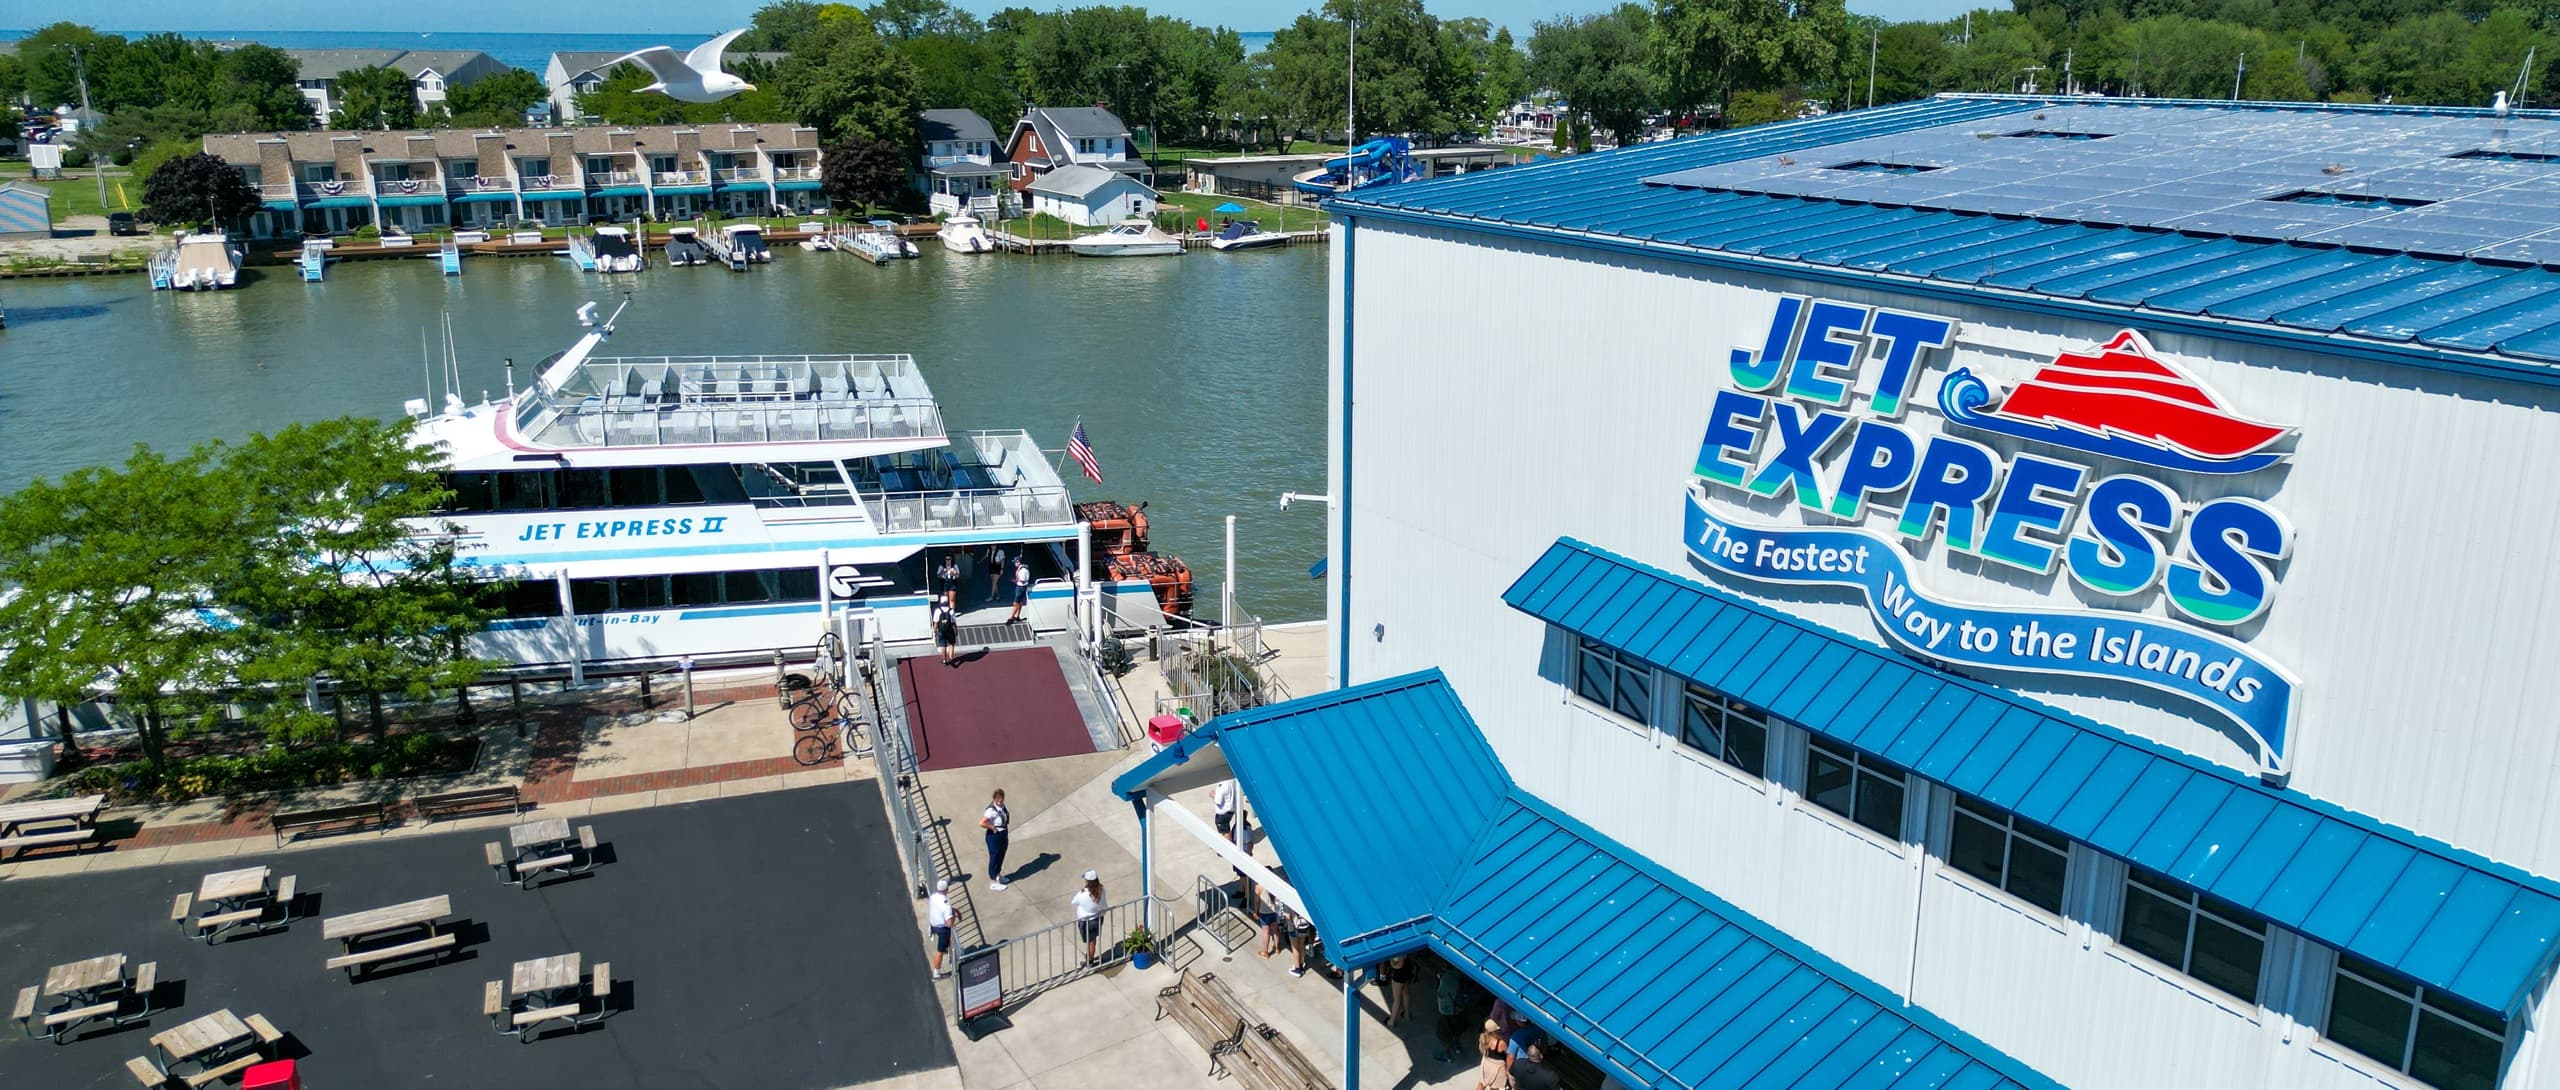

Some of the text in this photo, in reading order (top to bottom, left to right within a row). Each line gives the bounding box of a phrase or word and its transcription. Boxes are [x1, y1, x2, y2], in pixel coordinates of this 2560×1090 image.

[1729, 295, 1954, 416] JET
[518, 516, 728, 541] JET EXPRESS II
[1692, 388, 2286, 625] EXPRESS
[1698, 519, 2263, 704] The Fastest Way to the Islands
